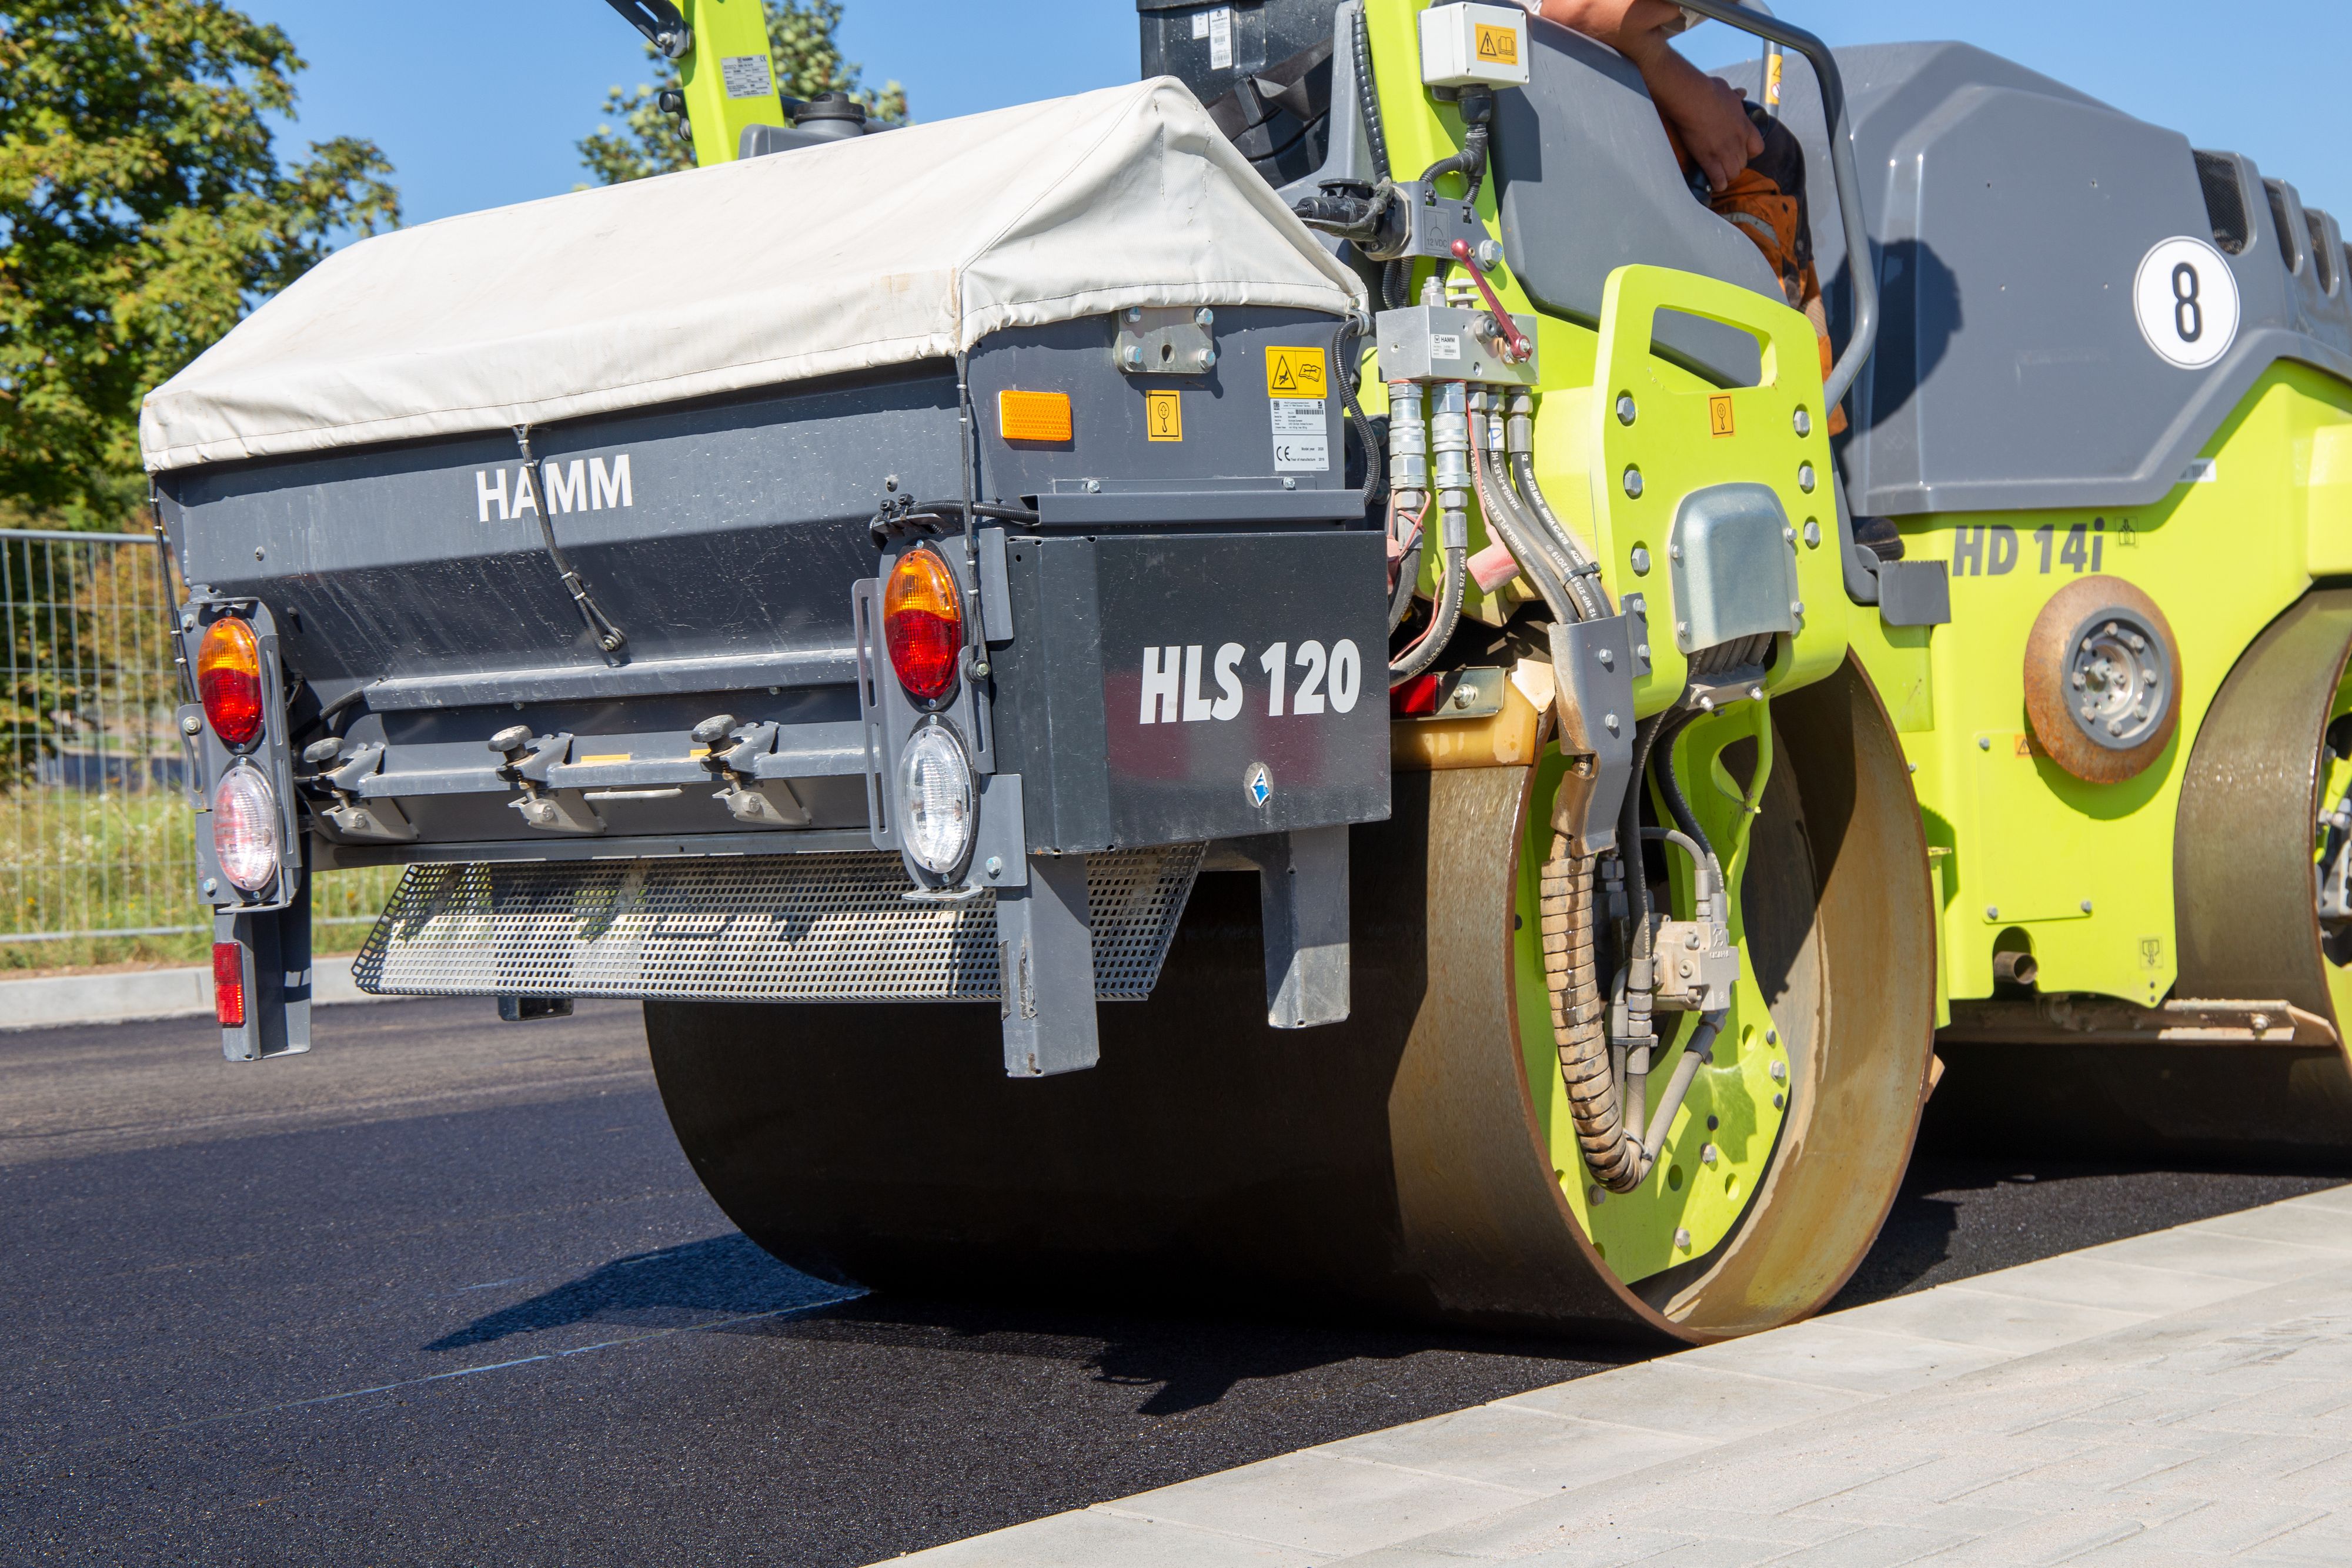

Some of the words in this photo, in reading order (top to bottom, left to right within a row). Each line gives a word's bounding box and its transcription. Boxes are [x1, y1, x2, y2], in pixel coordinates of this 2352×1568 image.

[2172, 262, 2202, 342] 8
[1489, 427, 1502, 451] P
[1277, 446, 1290, 461] CE
[1521, 453, 1529, 462] 12
[1524, 467, 1532, 480] WP
[476, 454, 633, 522] HAMM
[1493, 463, 1521, 510] HANSA-FLEX
[1528, 480, 1536, 491] 275
[1532, 491, 1544, 506] BAR
[1541, 507, 1555, 526] MSHA
[1493, 510, 1528, 556] HANSA-FLEX
[1952, 524, 2019, 576] HD
[2033, 517, 2105, 574] 14i
[1460, 556, 1466, 570] WP
[1552, 551, 1568, 568] 2Q19
[1570, 549, 1583, 565] 4Q20
[1574, 581, 1586, 594] 275
[1456, 589, 1464, 608] BAR
[1582, 596, 1592, 607] WP
[1589, 607, 1597, 618] 12
[1446, 611, 1460, 636] MSHA
[1140, 642, 1246, 724] HLS
[1260, 638, 1361, 717] 120
[1639, 724, 1659, 769] HANSA-FLEX
